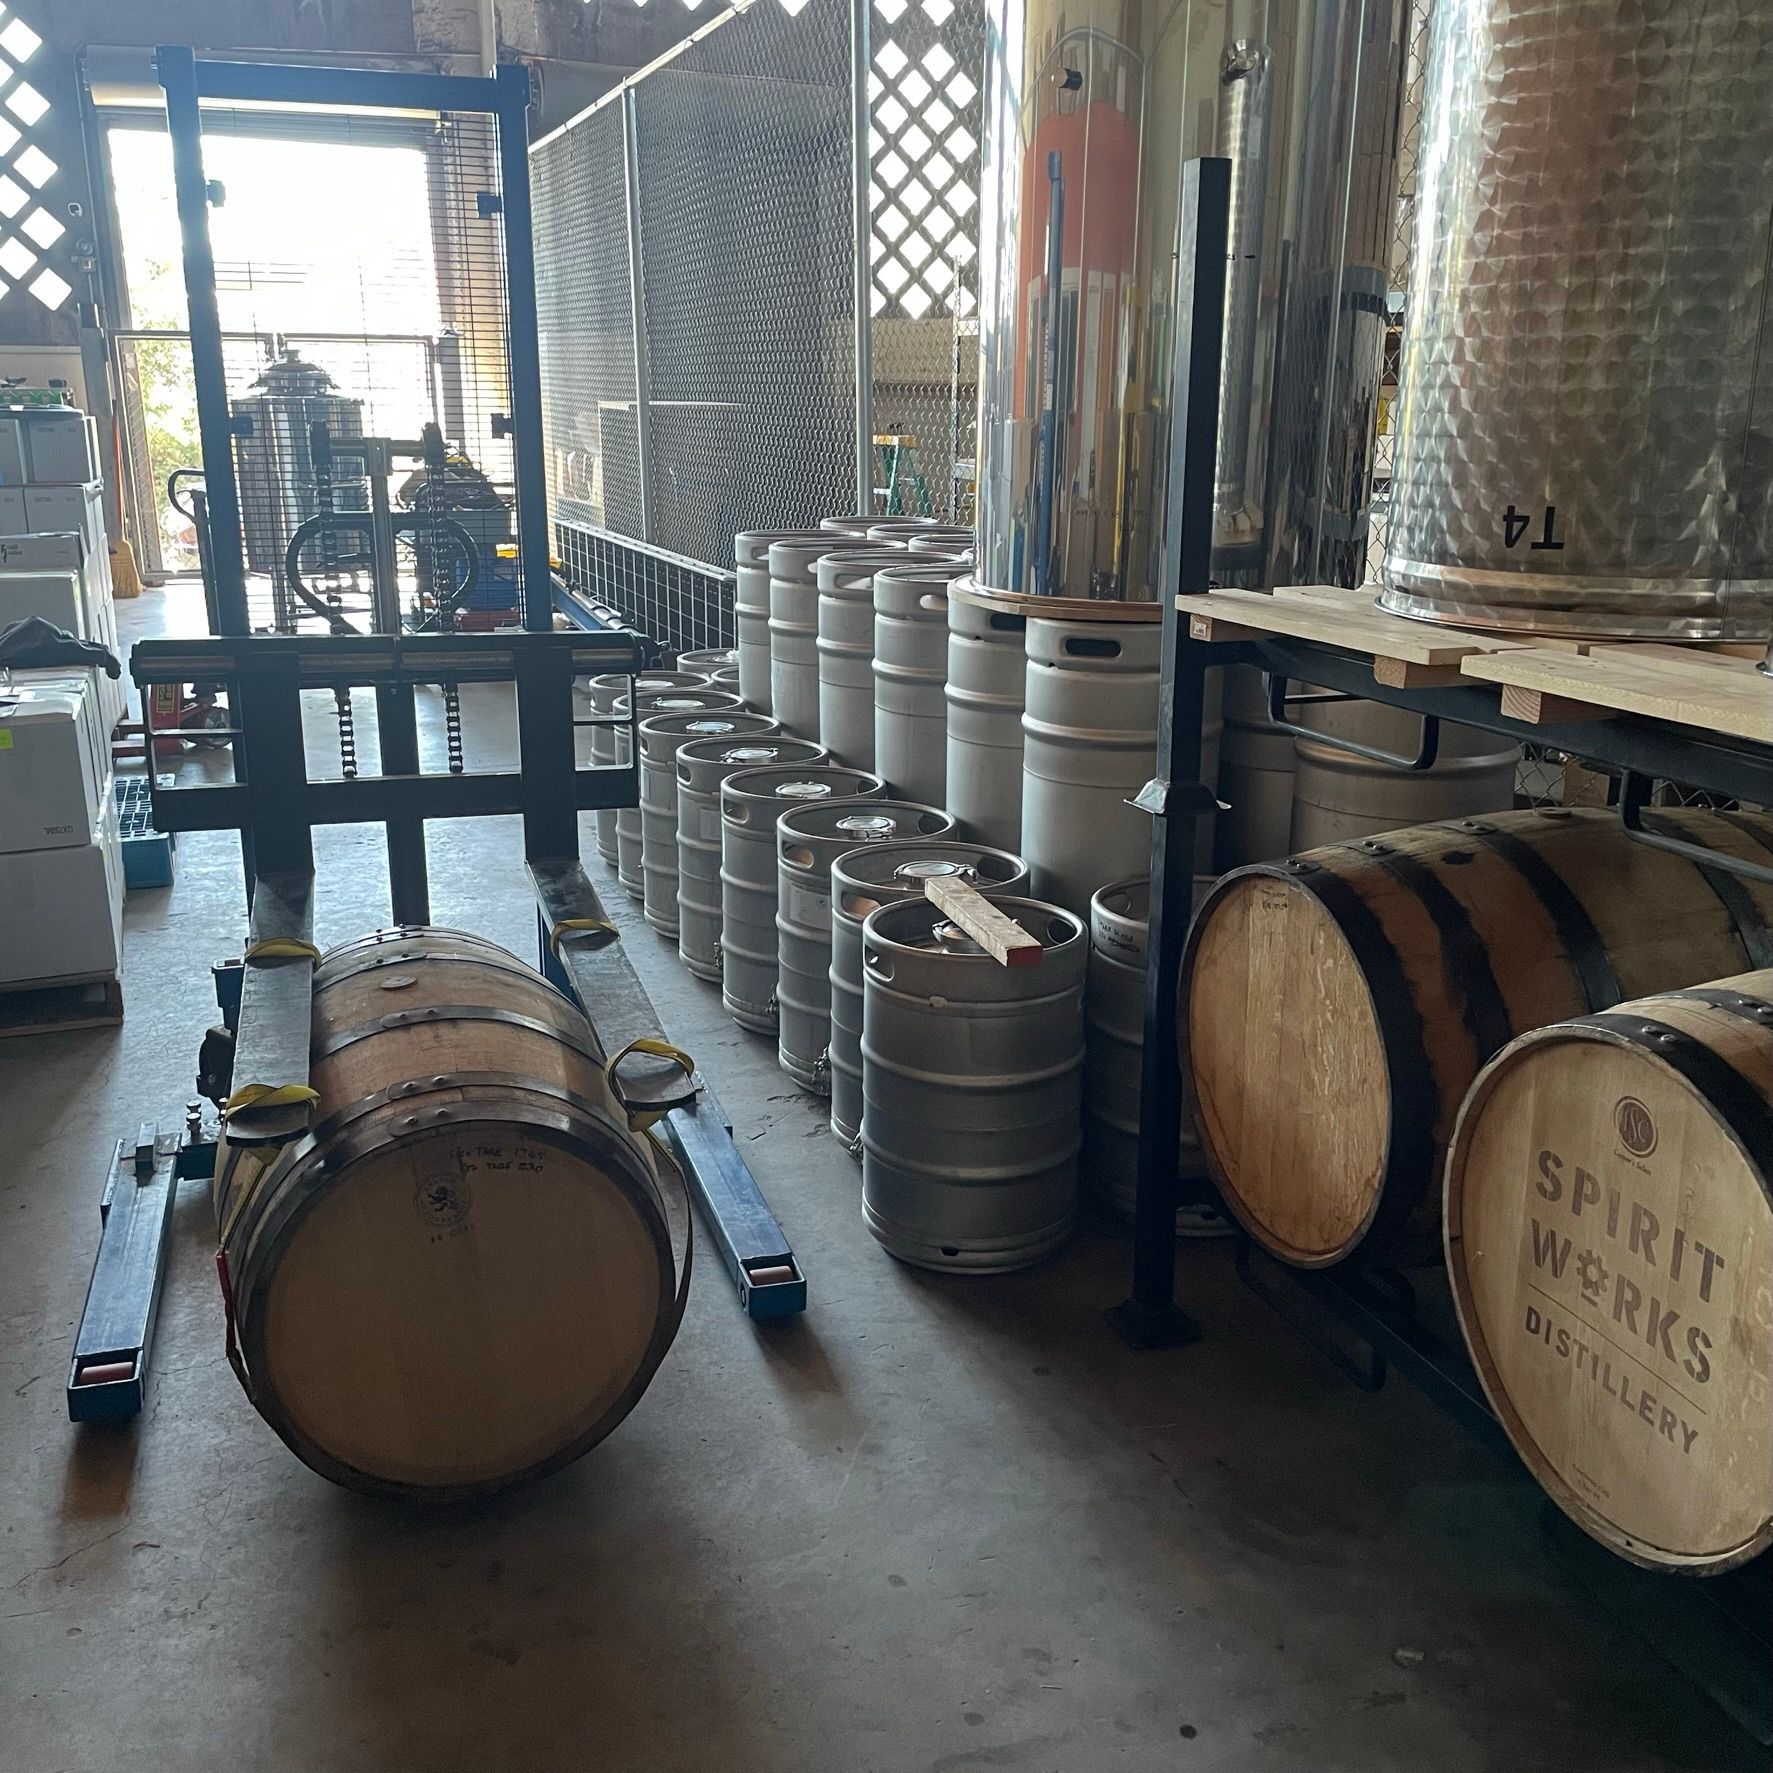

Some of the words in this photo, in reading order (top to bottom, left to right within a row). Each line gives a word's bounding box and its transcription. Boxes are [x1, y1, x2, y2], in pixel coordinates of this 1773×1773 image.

[1503, 506, 1564, 549] T4
[1536, 1150, 1725, 1303] SPIRIT
[1525, 1305, 1699, 1454] DISTILLERY
